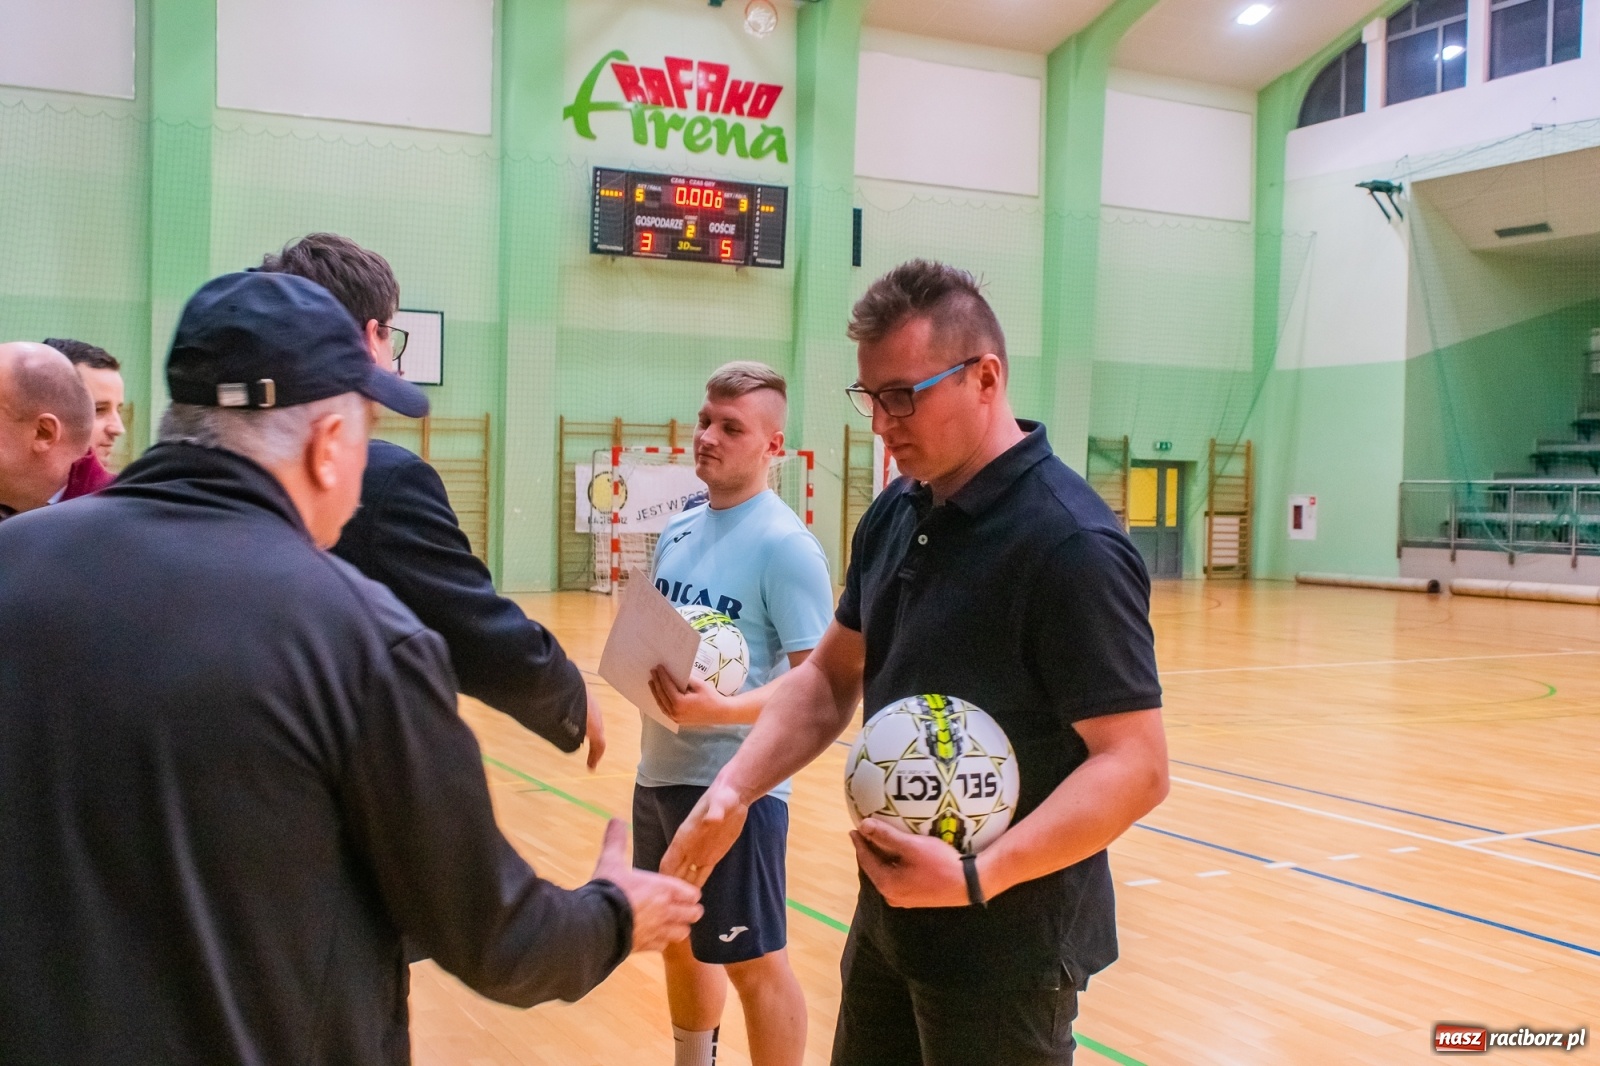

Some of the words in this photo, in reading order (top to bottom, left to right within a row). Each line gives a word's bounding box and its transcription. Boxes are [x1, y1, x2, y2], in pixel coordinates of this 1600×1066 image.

[563, 50, 788, 163] Arena
[635, 188, 645, 202] 5
[739, 199, 748, 212] 3
[635, 215, 684, 230] GOSPODARZE
[709, 221, 736, 235] GOŚCIE
[686, 225, 695, 238] 2
[641, 232, 652, 251] 3
[721, 240, 732, 257] 5
[636, 502, 664, 521] JEST
[667, 499, 679, 511] W
